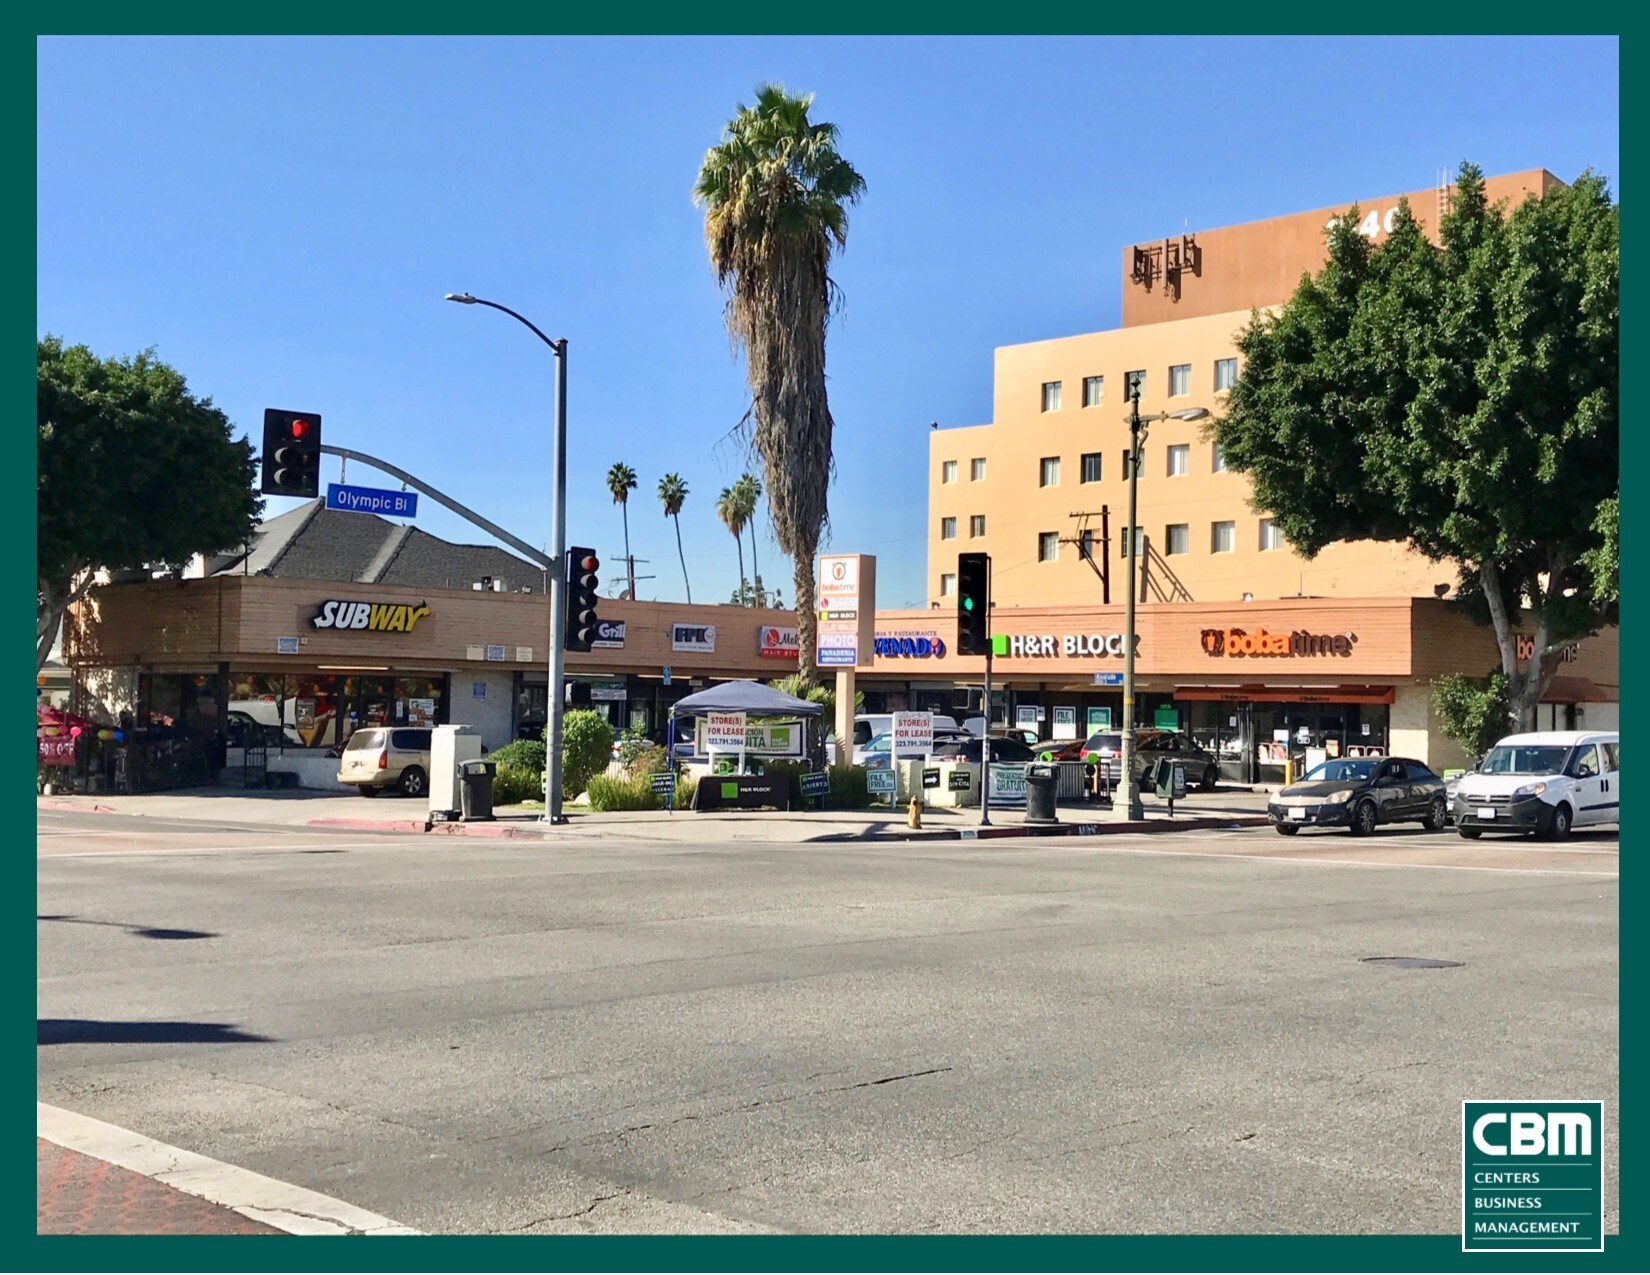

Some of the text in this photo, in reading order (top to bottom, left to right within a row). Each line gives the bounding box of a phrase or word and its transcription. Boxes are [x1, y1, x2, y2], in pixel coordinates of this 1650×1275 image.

[337, 490, 407, 511] Olympic Bl
[314, 601, 431, 632] SUBWAY
[598, 623, 625, 638] Grill
[821, 634, 856, 646] PHOTO
[1011, 635, 1054, 654] H&R
[1224, 629, 1349, 654] bobatime
[710, 717, 742, 726] STORE(S)
[1058, 711, 1069, 719] FILE
[898, 719, 930, 728] STORE(S)
